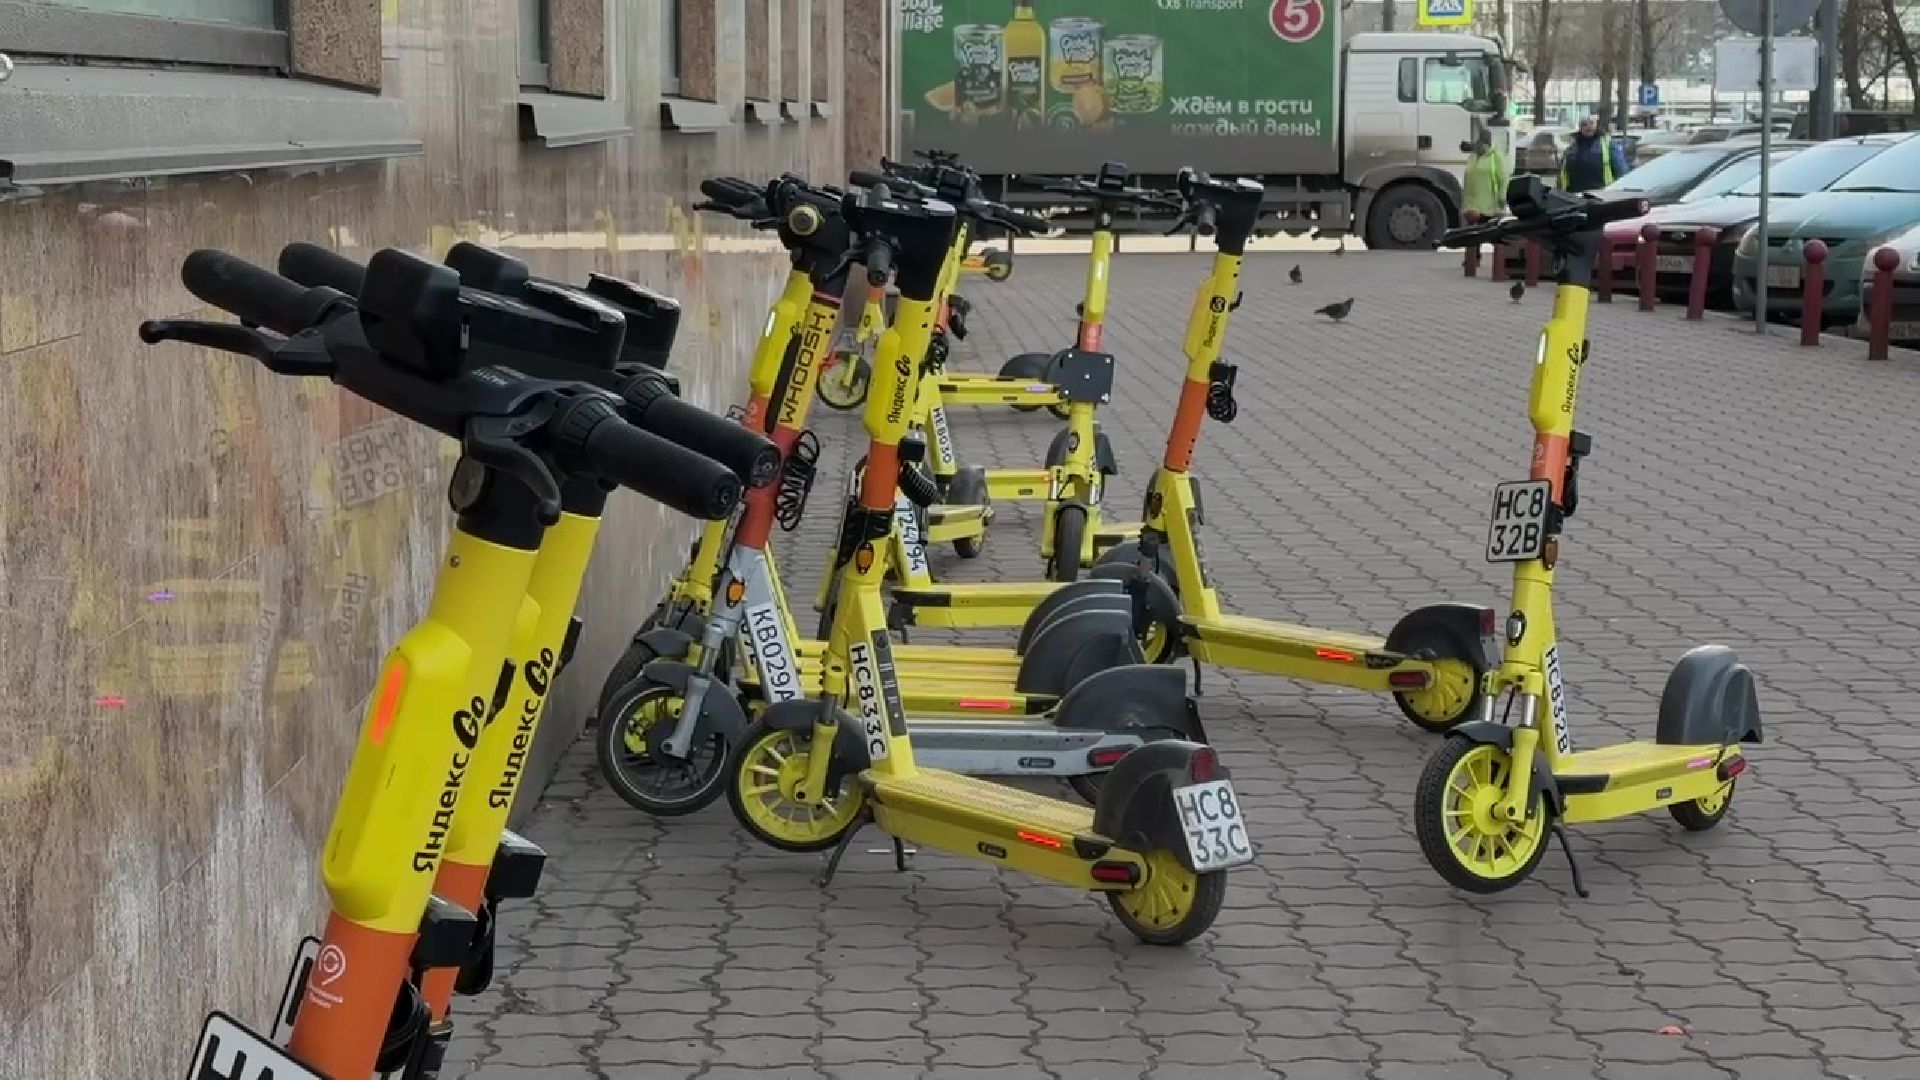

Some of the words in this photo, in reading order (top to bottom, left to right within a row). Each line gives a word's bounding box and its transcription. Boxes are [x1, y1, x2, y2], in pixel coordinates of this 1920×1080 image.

[1284, 0, 1309, 32] 5
[1170, 96, 1232, 115] Ждём
[1239, 104, 1250, 114] в
[1255, 99, 1313, 115] гости
[1264, 117, 1321, 137] день!
[780, 311, 827, 424] WHOOSH
[1561, 367, 1577, 414] Яндекс
[888, 375, 908, 424] Яндекс
[489, 699, 541, 809] Яндекс
[524, 647, 553, 697] Go
[412, 752, 470, 873] Яндекс
[453, 695, 485, 749] Go
